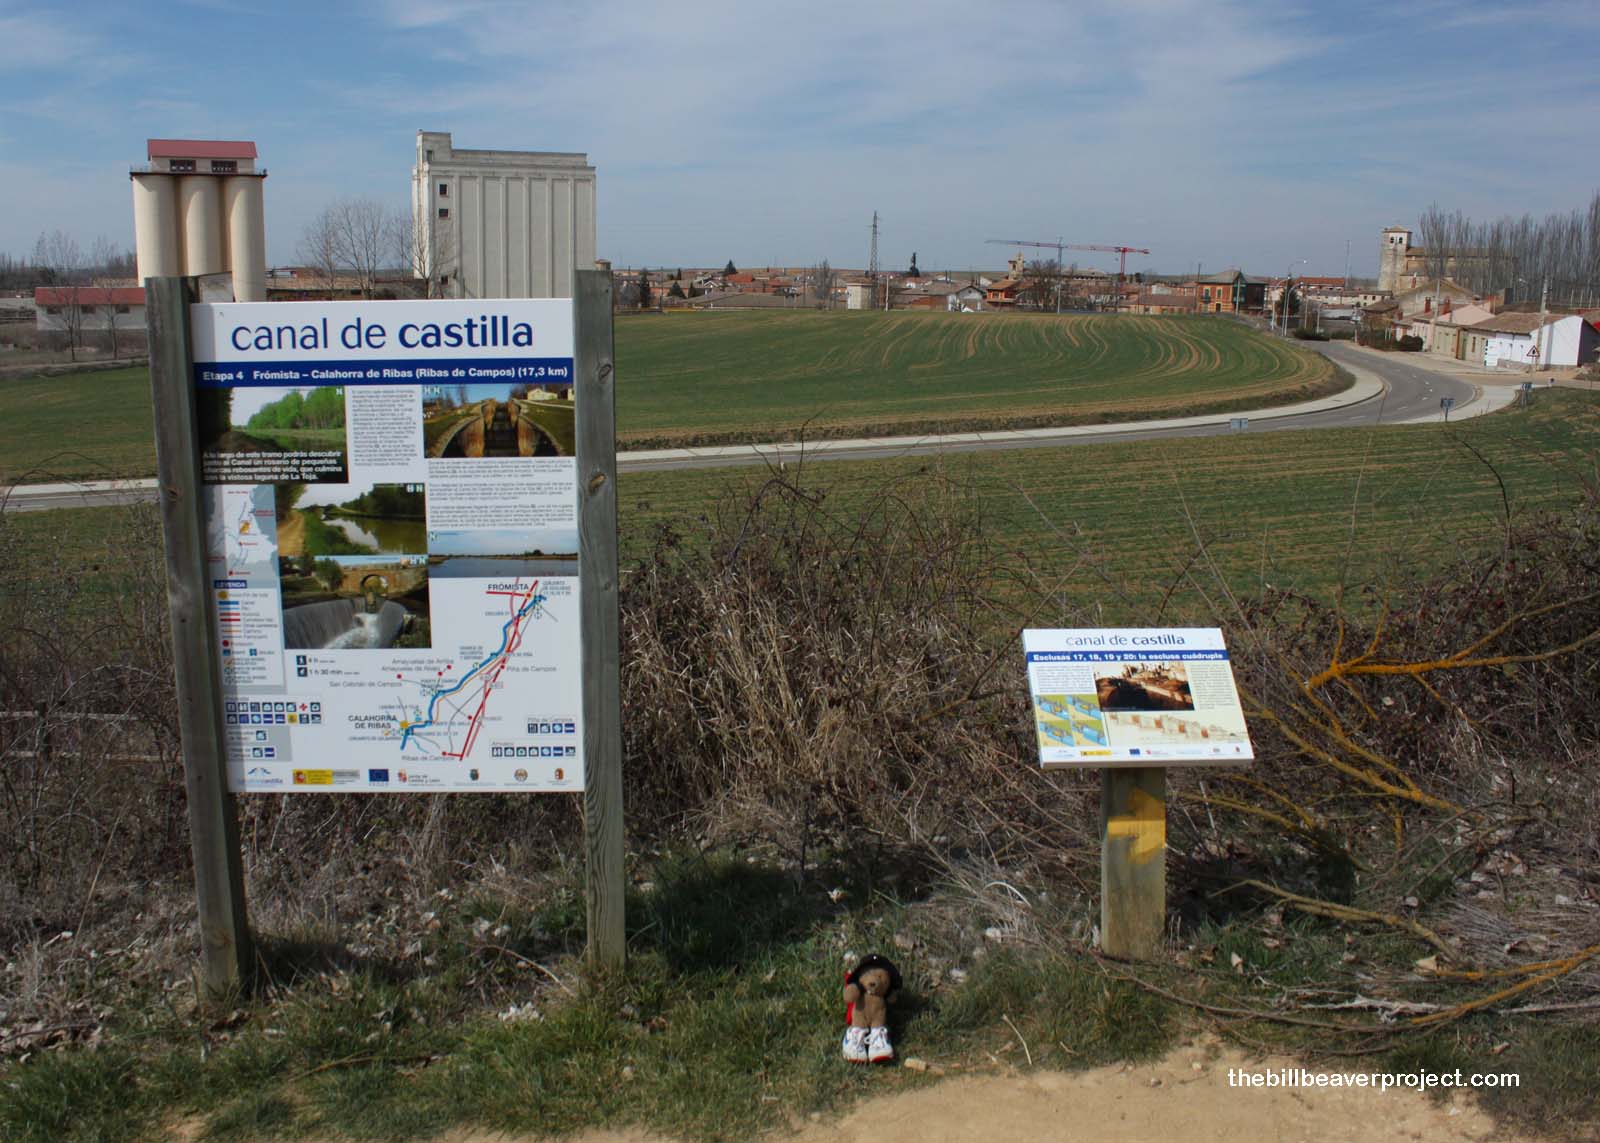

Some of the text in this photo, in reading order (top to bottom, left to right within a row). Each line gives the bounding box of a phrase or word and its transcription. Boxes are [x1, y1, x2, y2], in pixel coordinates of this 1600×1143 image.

[231, 315, 534, 351] canal de castilla
[202, 371, 234, 382] Etapa
[236, 371, 244, 381] 4
[253, 370, 300, 380] Frómista
[311, 368, 364, 379] Calahorra
[367, 368, 381, 378] de
[383, 368, 413, 378] Ribas
[416, 367, 449, 379] (Ribas
[452, 367, 466, 377] de
[468, 367, 516, 379] Campos)
[518, 366, 545, 378] (17,3
[548, 366, 568, 378] km)
[1066, 634, 1185, 646] canal de castilla
